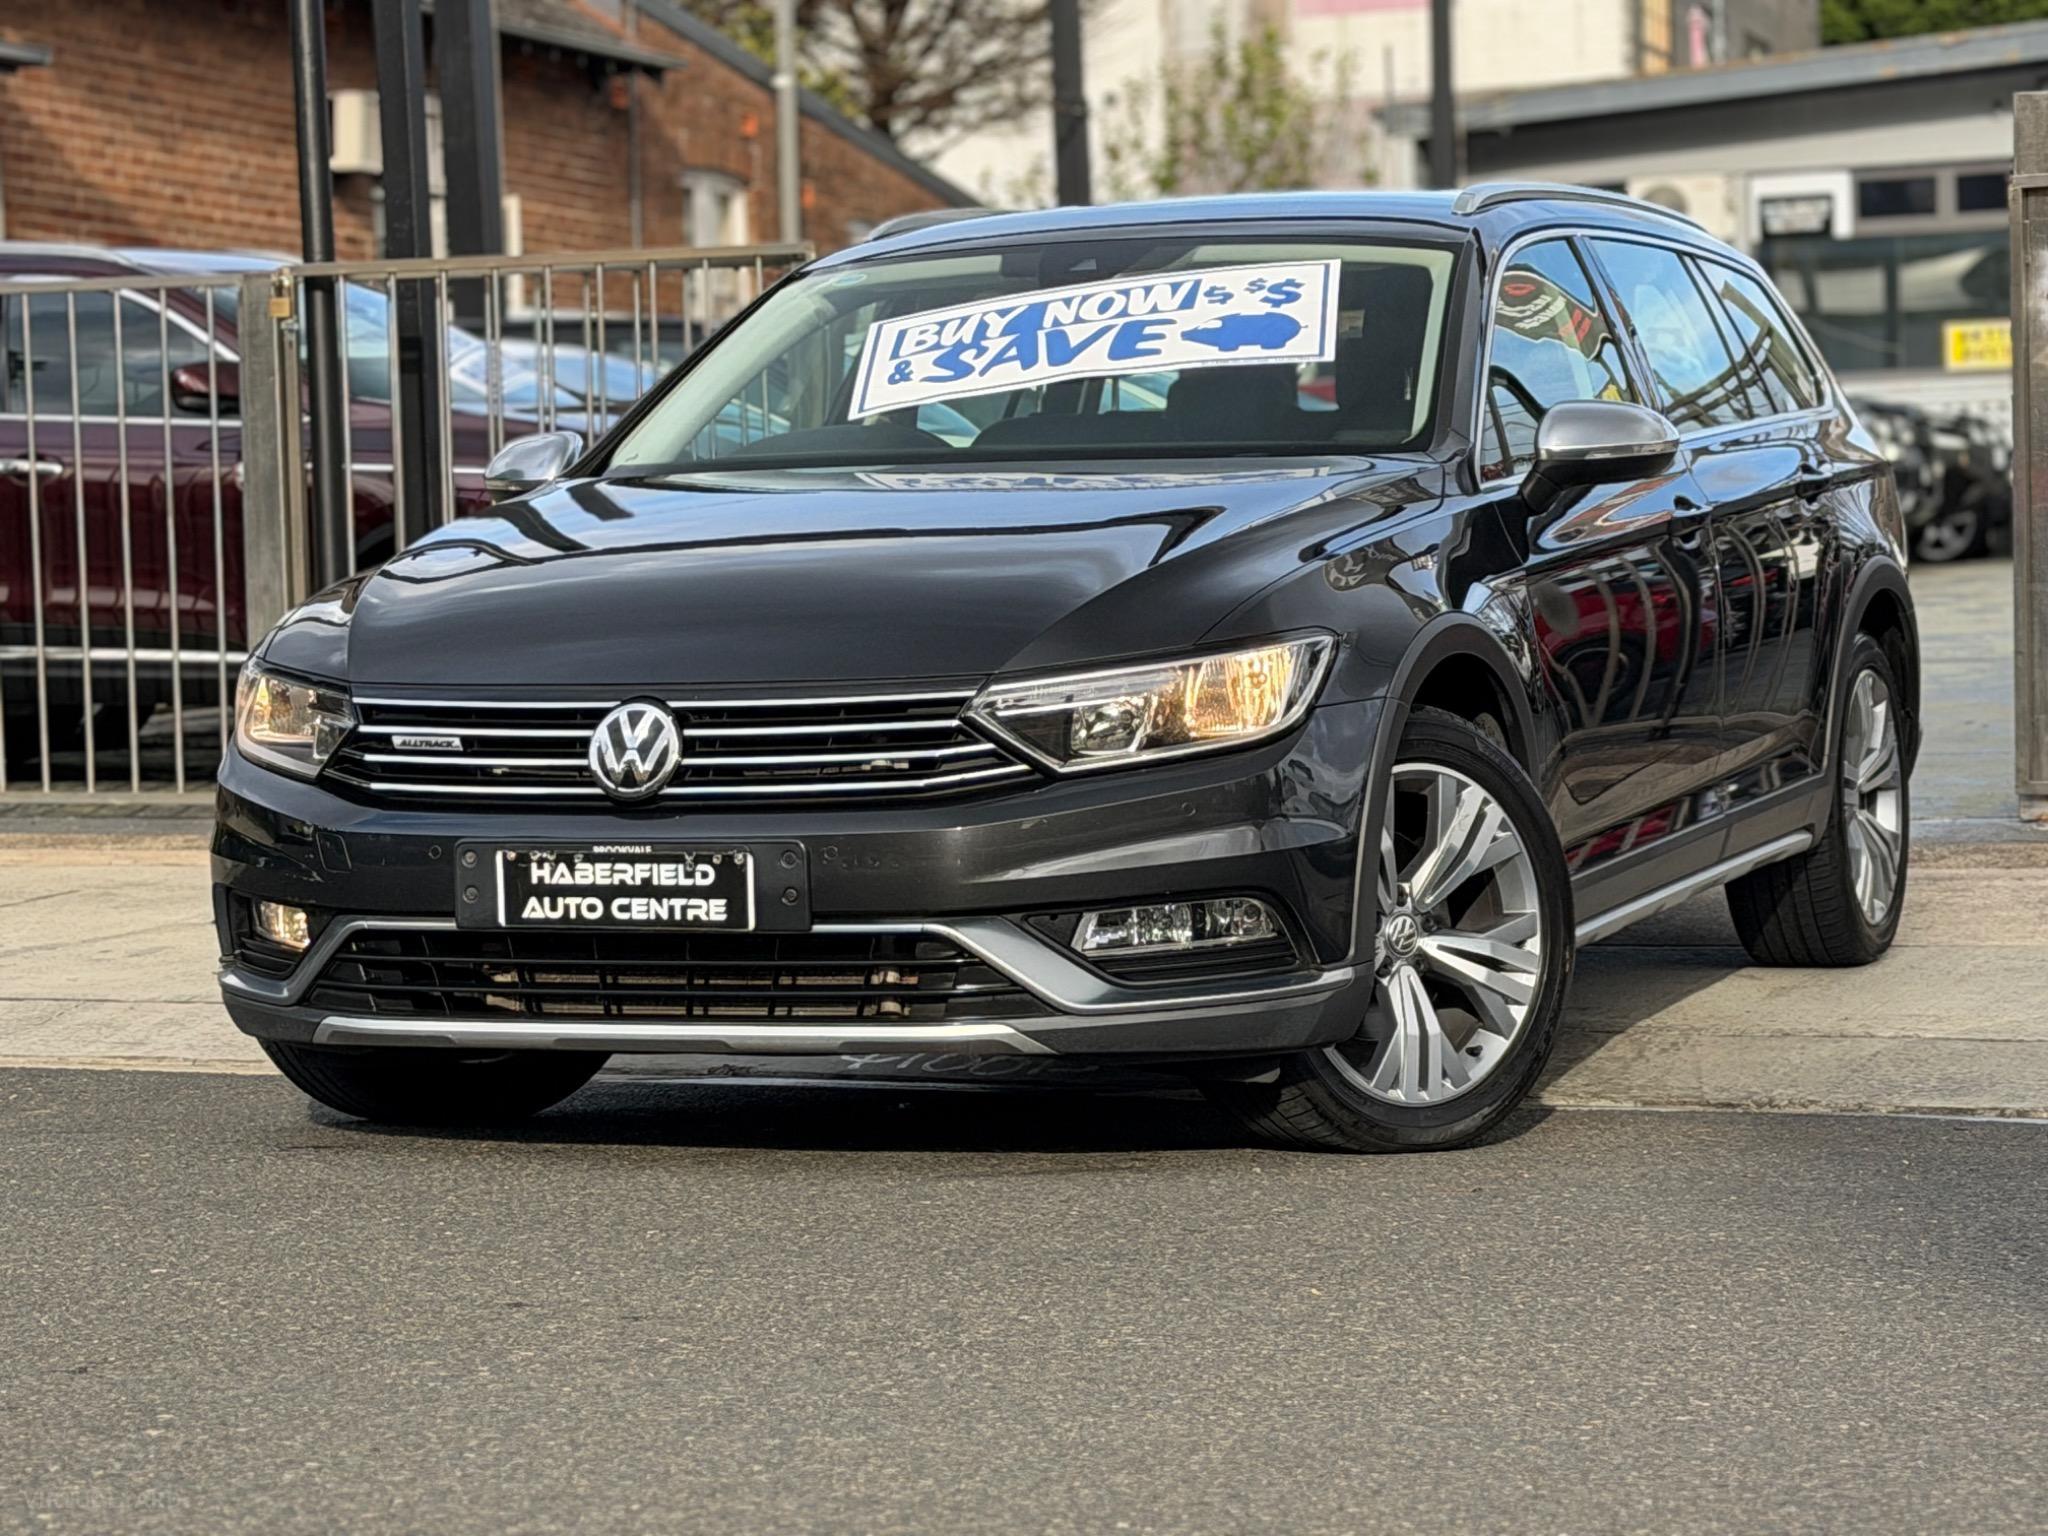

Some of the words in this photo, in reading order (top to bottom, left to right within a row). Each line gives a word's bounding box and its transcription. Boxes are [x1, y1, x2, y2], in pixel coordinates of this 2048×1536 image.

[900, 304, 1029, 357] BUY
[1043, 281, 1195, 329] NOW
[887, 360, 914, 386] &
[920, 305, 1179, 384] SAVE
[530, 861, 716, 887] HABERFIELD
[521, 896, 605, 920] AUTO
[611, 898, 728, 922] CENTRE
